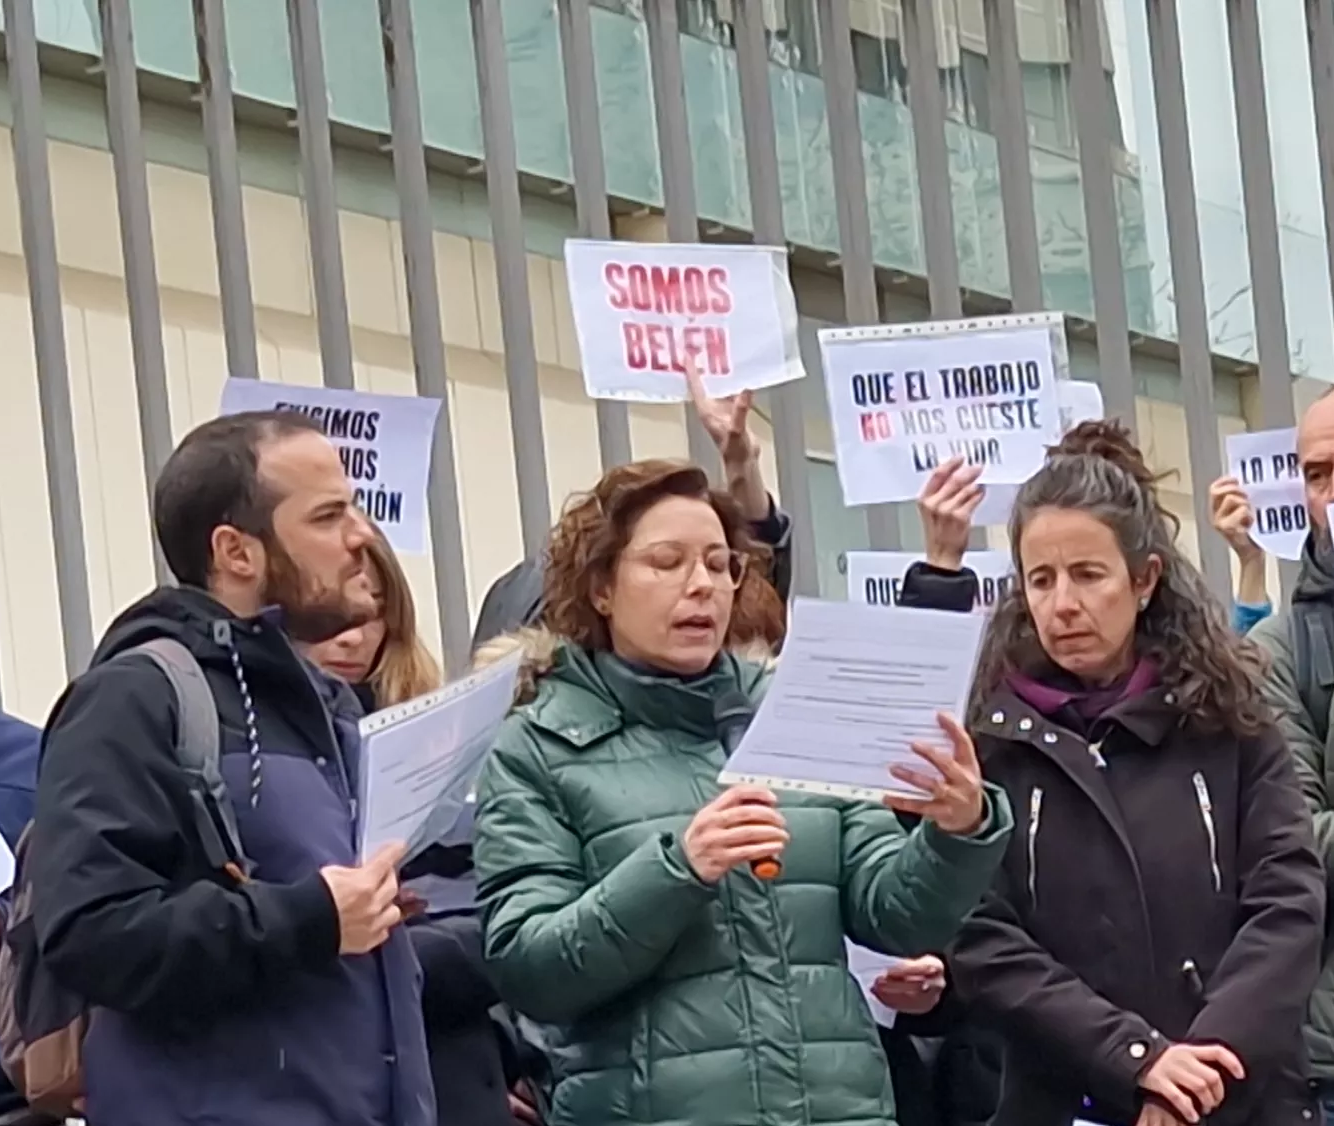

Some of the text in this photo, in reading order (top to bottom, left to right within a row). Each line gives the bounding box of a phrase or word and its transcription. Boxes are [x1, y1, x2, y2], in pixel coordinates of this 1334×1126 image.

[605, 262, 732, 314] SOMOS
[622, 317, 731, 375] BELÉN
[852, 360, 1042, 407] QUE EL TRABAJO
[860, 411, 891, 442] NO
[901, 408, 948, 436] NOS
[956, 398, 1042, 431] CUESTE
[912, 442, 938, 472] LA
[1240, 457, 1263, 484] LA
